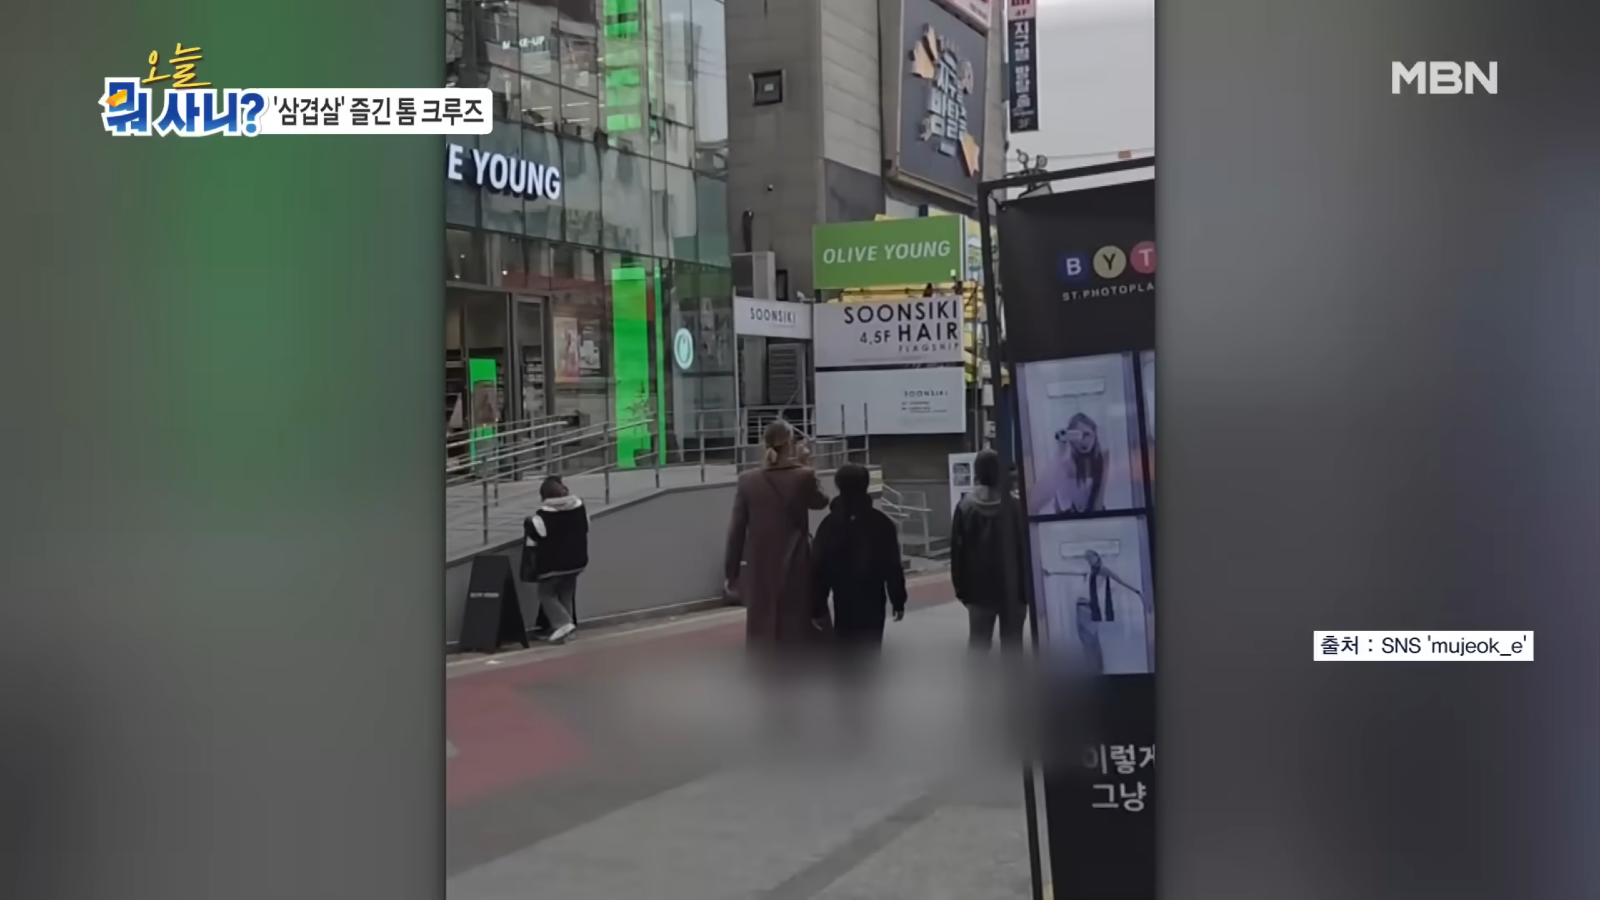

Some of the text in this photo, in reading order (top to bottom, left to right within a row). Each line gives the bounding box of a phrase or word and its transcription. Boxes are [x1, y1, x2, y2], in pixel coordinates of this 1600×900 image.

[502, 35, 545, 50] MKE-UP
[446, 143, 561, 200] E YOUNG
[823, 240, 951, 265] OLIVE YOUNG
[750, 306, 797, 324] SOONSIKI
[844, 300, 959, 325] SOONSIKI
[898, 322, 959, 342] HAIR
[898, 342, 960, 353] FLAGSHIP
[1092, 782, 1147, 812] 그냥
